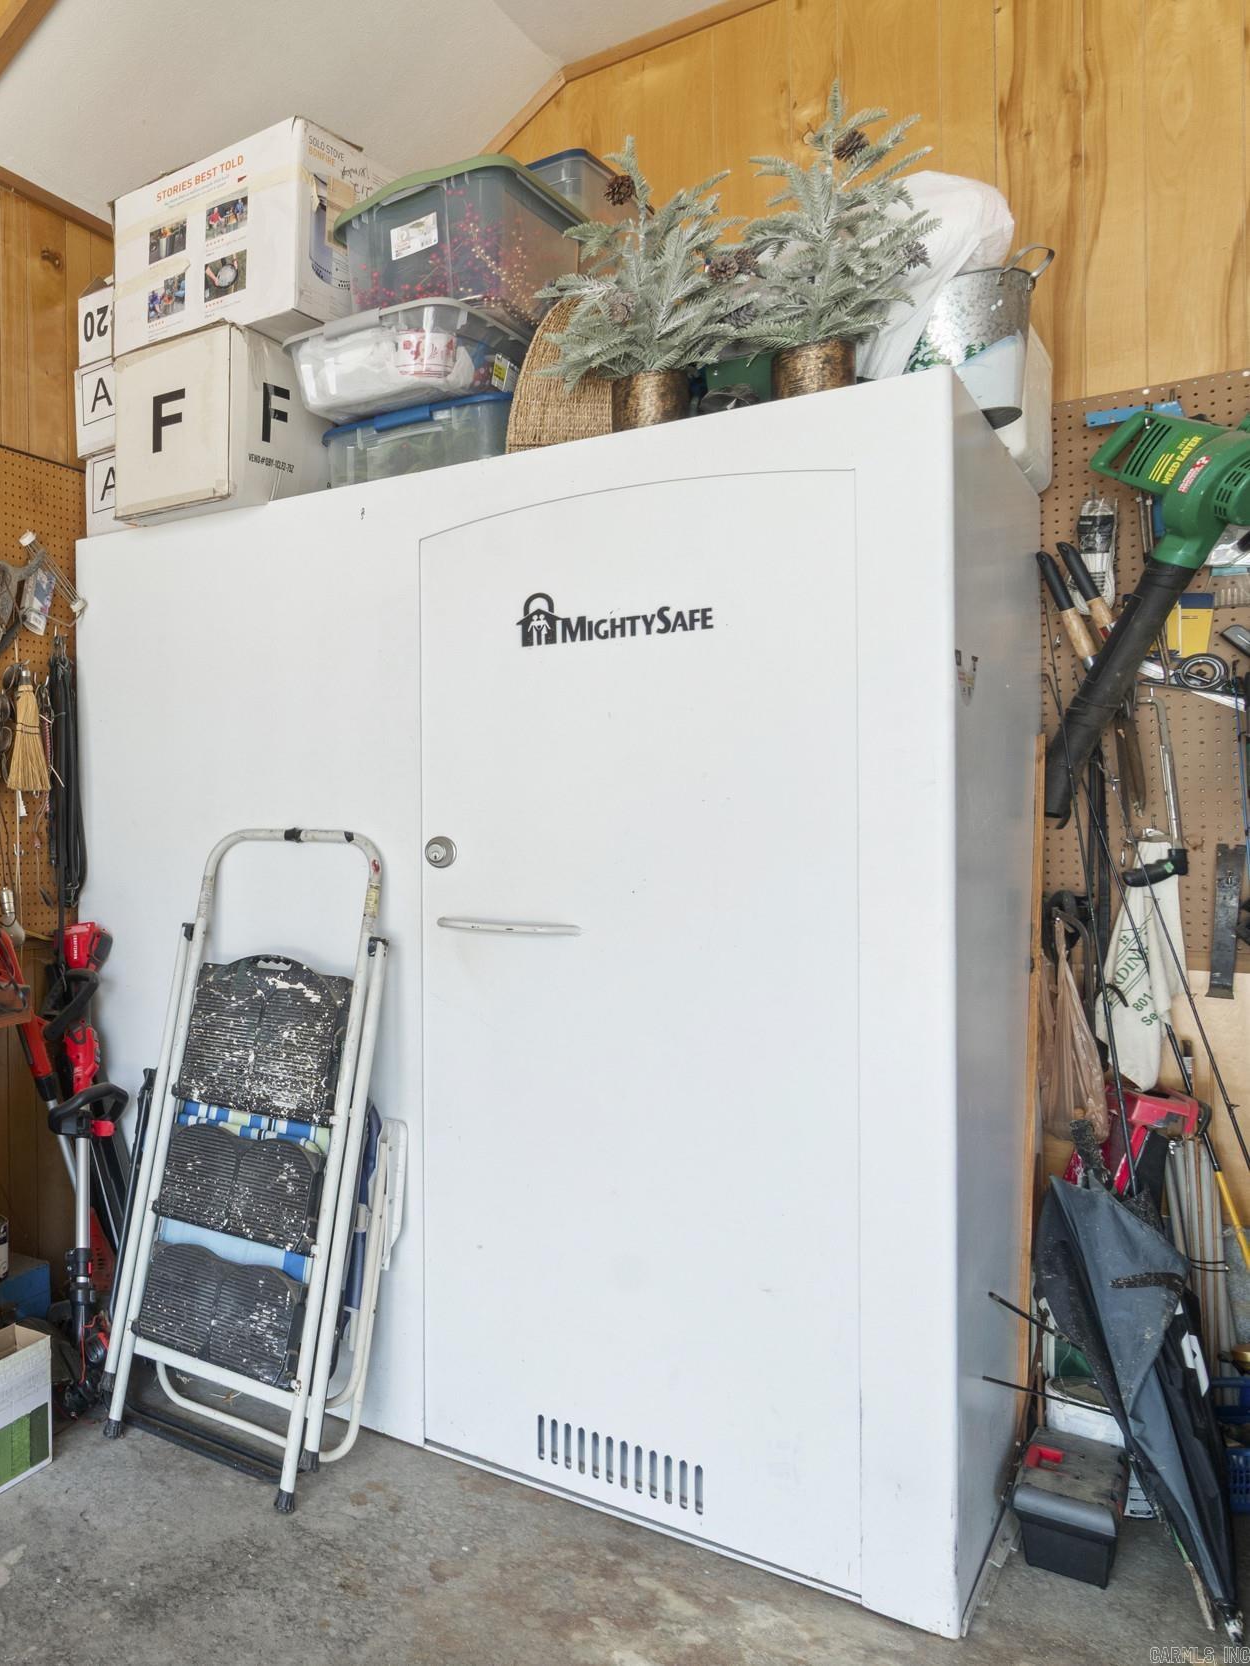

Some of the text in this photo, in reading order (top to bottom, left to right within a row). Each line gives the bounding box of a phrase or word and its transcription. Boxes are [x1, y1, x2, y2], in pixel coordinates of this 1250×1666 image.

[308, 135, 345, 162] SOLO STOVE
[308, 145, 336, 167] BONFIRE
[156, 179, 193, 202] STORIES
[194, 166, 218, 186] BEST
[220, 154, 244, 173] TOLD
[91, 376, 114, 413] A
[261, 381, 291, 443] F
[152, 388, 186, 454] F
[1161, 461, 1181, 485] WEED
[1176, 435, 1203, 462] EATER
[100, 466, 116, 502] A
[1132, 992, 1154, 1012] 801
